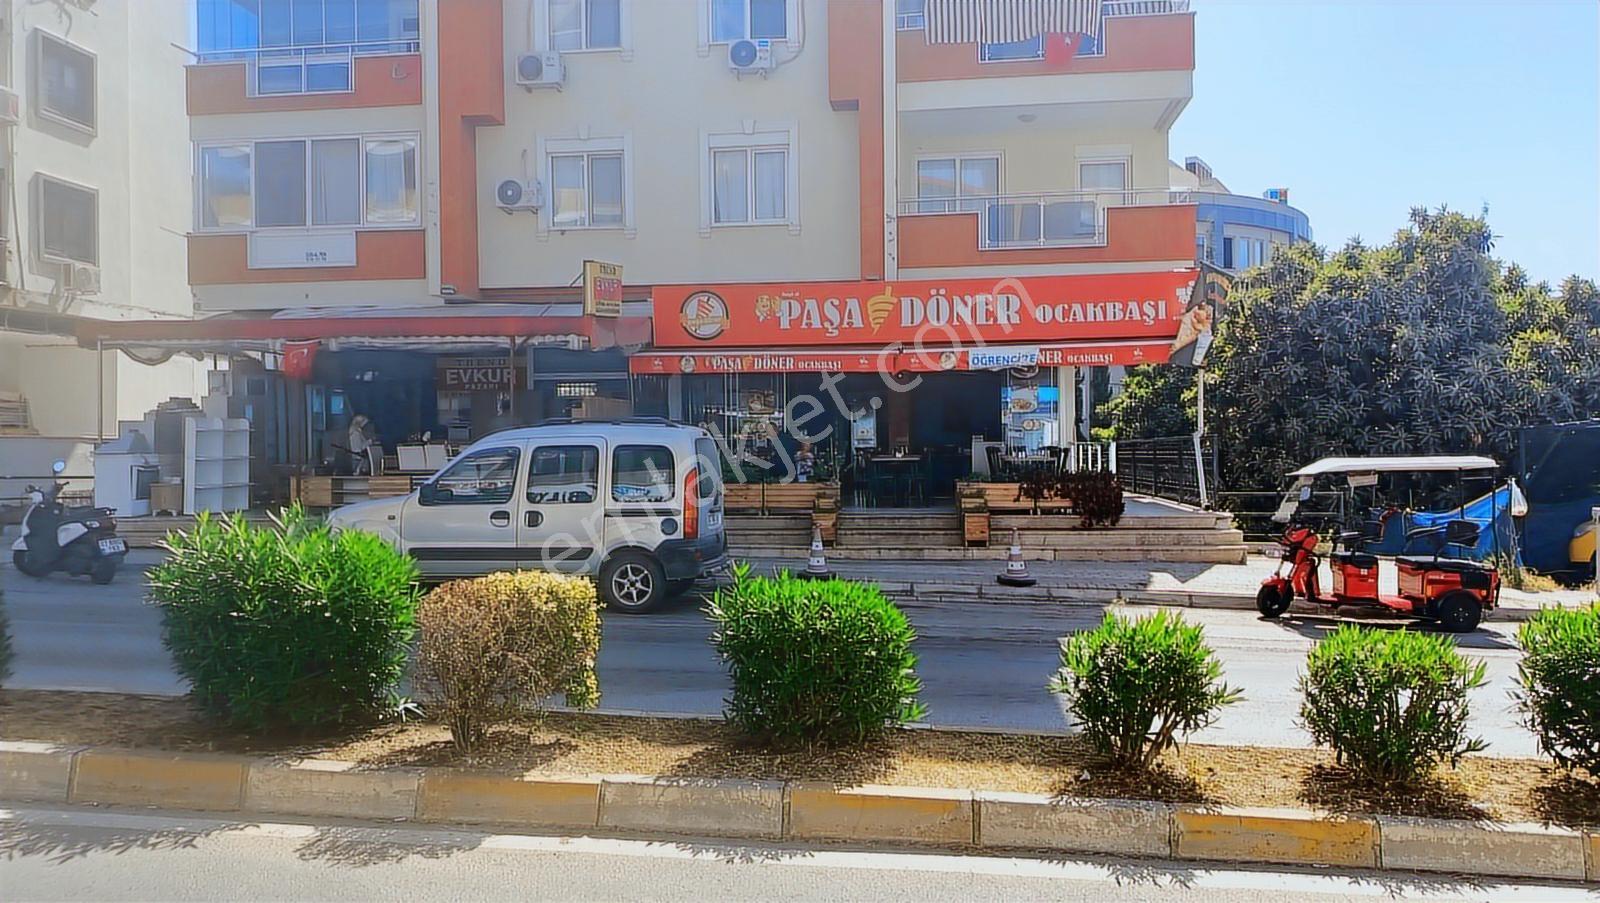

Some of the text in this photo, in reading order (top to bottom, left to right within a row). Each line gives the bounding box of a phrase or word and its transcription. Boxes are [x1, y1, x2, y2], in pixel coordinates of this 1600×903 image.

[777, 296, 865, 337] PAŞA
[900, 288, 1021, 327] DÖNER
[1034, 298, 1167, 326] OCAKBAŞI
[713, 356, 744, 371] PAŞA
[754, 353, 795, 370] DÖNER
[1037, 350, 1063, 364] NER
